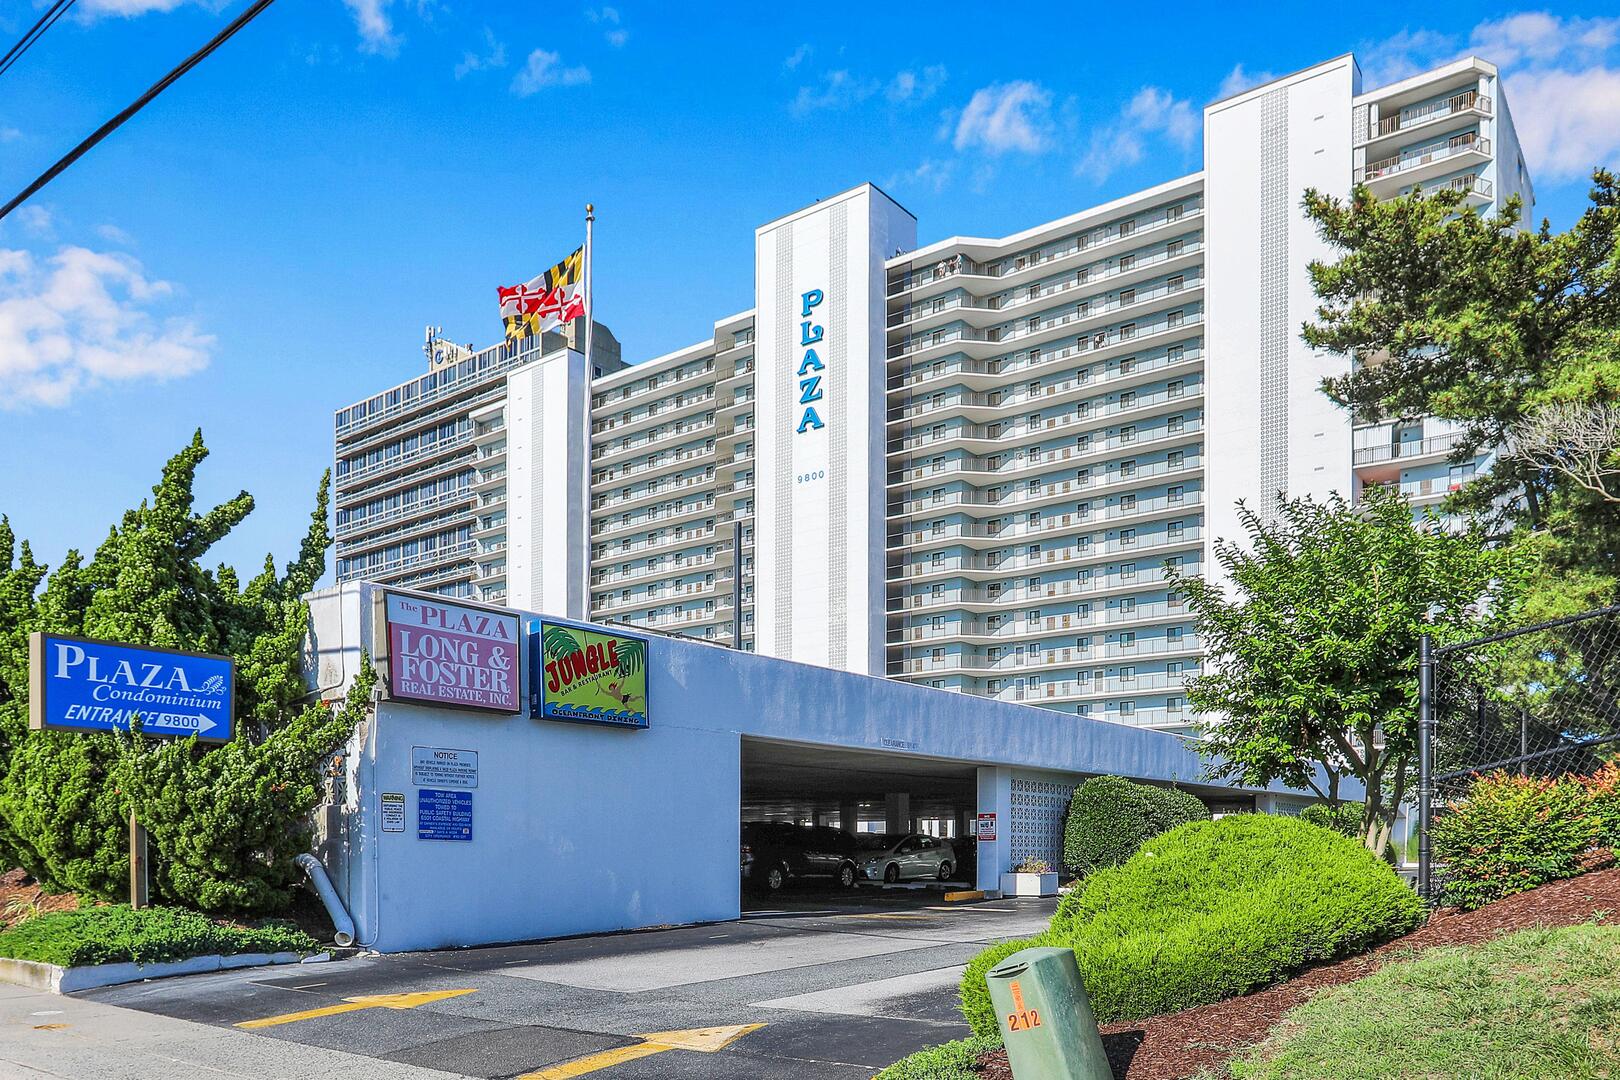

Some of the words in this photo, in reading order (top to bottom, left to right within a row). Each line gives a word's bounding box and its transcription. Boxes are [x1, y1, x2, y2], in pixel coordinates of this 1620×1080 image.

[797, 289, 825, 434] PLAZA
[797, 470, 825, 484] 9800
[399, 601, 418, 612] The
[420, 605, 510, 640] PLAZA
[400, 630, 479, 666] LONG
[487, 646, 511, 671] &
[54, 643, 193, 692] PLAZA
[400, 655, 511, 694] FOSTER
[545, 639, 620, 694] JUNGLE
[401, 681, 435, 696] REAL
[438, 685, 487, 704] ESTATE,
[489, 692, 512, 706] INC.
[560, 687, 572, 697] BAR
[578, 669, 613, 687] RESTAURANT
[92, 684, 222, 710] Condominium
[163, 714, 200, 728] 9800
[551, 708, 605, 720] OCEANFRONT
[608, 714, 640, 724] DINING
[433, 752, 458, 760] NOTICE
[1008, 1010, 1041, 1031] 212
